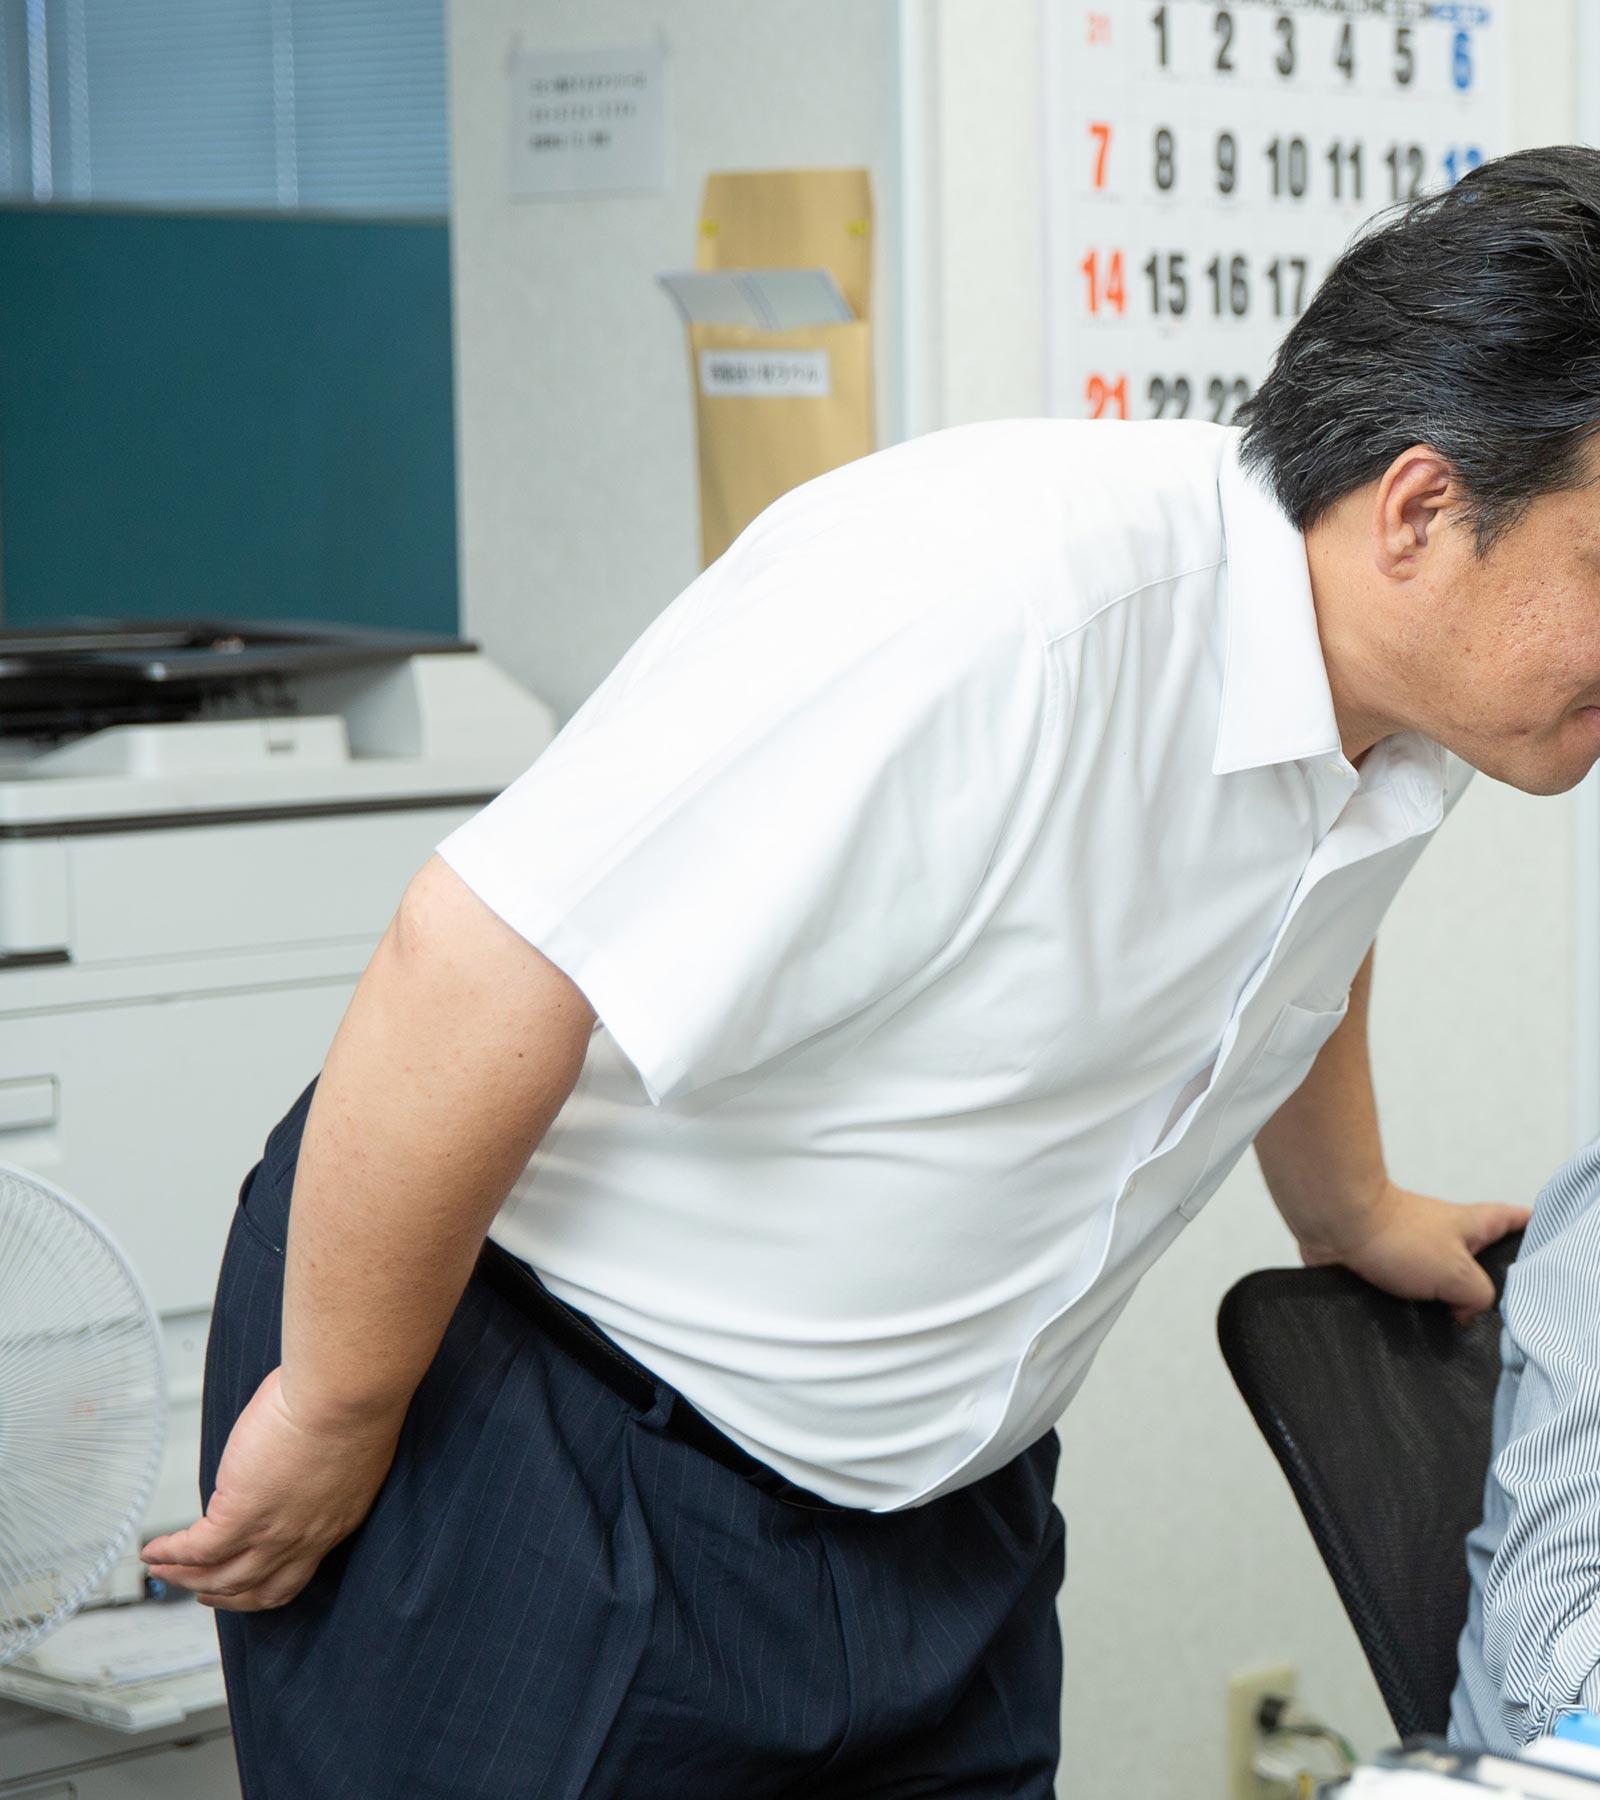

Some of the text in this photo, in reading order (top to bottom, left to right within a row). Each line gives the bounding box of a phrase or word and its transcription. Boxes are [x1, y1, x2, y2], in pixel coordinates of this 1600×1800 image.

[1151, 5, 1167, 67] 1
[1214, 10, 1234, 72] 2
[1274, 15, 1295, 76] 3
[1336, 20, 1353, 80] 4
[1395, 27, 1414, 86] 5
[1452, 30, 1473, 90] 6
[1088, 124, 1112, 190] 7
[1153, 127, 1175, 191] 8
[1216, 132, 1236, 195] 9
[1264, 136, 1308, 198] 10
[1325, 141, 1363, 200] 11
[1385, 145, 1425, 202] 12
[1080, 249, 1308, 318] 14 15 16 17
[1085, 373, 1127, 420] 21
[1146, 374, 1192, 420] 22
